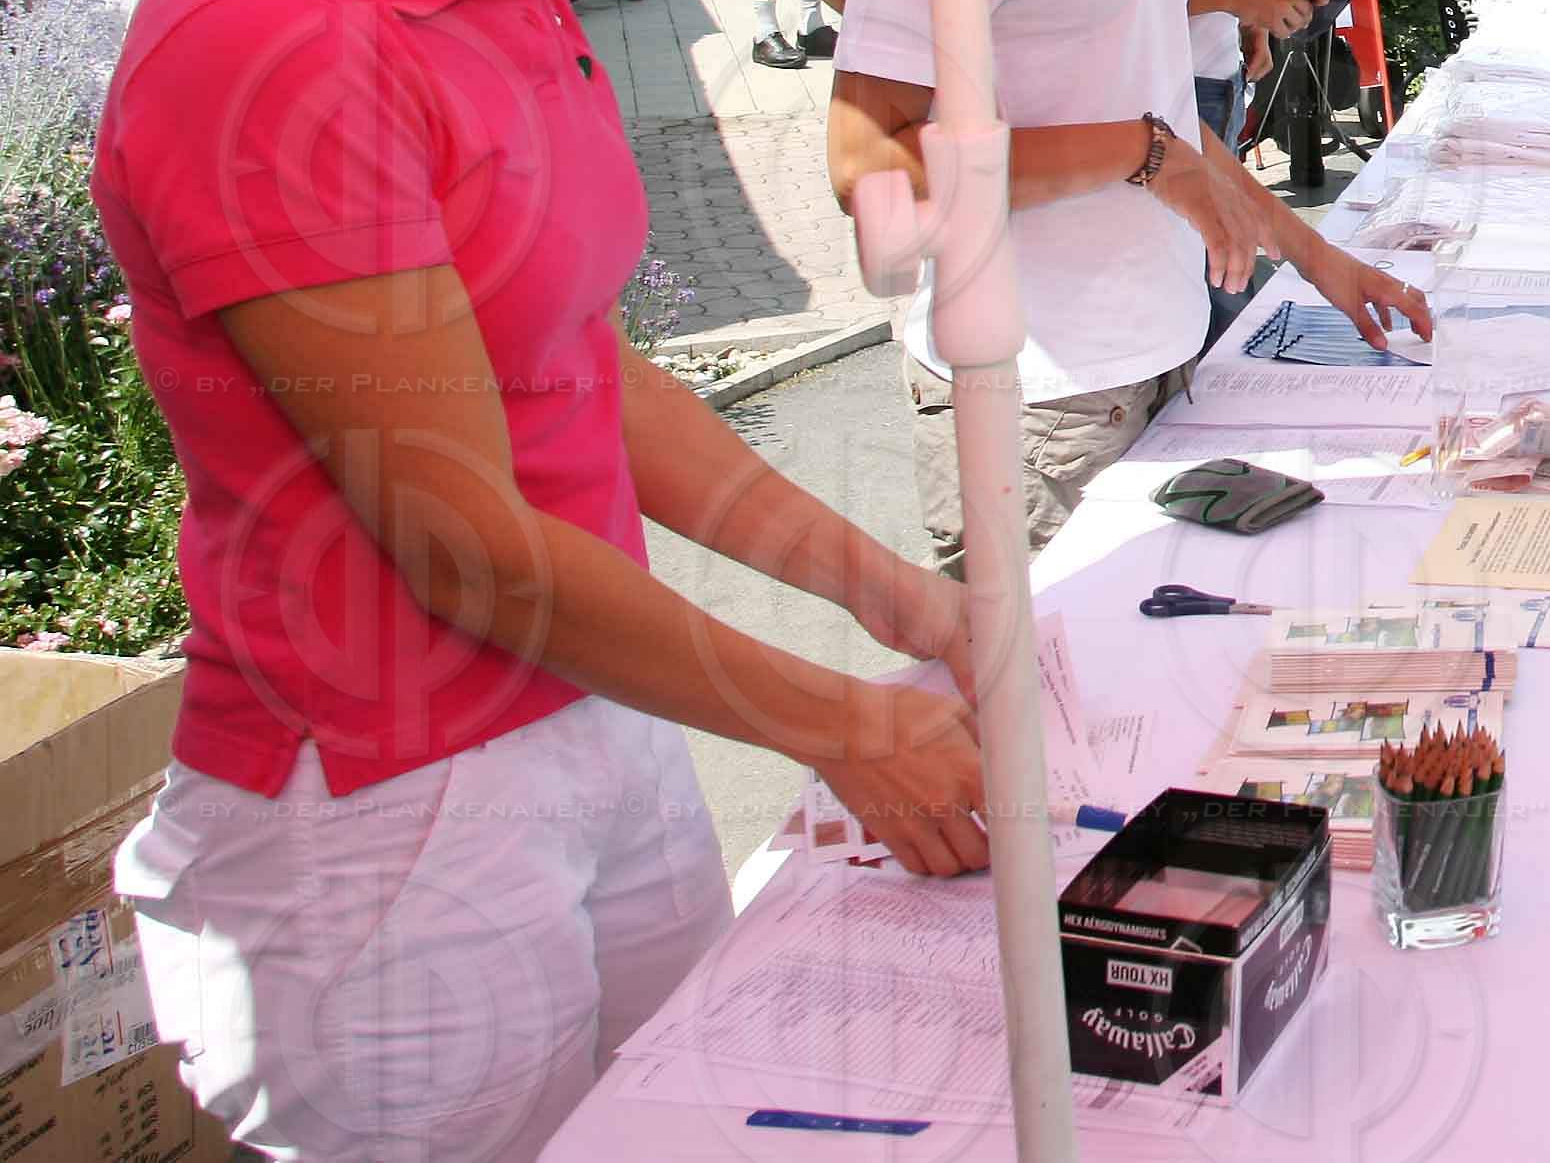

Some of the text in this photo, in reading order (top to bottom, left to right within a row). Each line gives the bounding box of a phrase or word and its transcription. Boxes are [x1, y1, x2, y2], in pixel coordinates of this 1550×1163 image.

[1111, 963, 1169, 988] HX TOUR
[1082, 1007, 1196, 1058] Callaway
